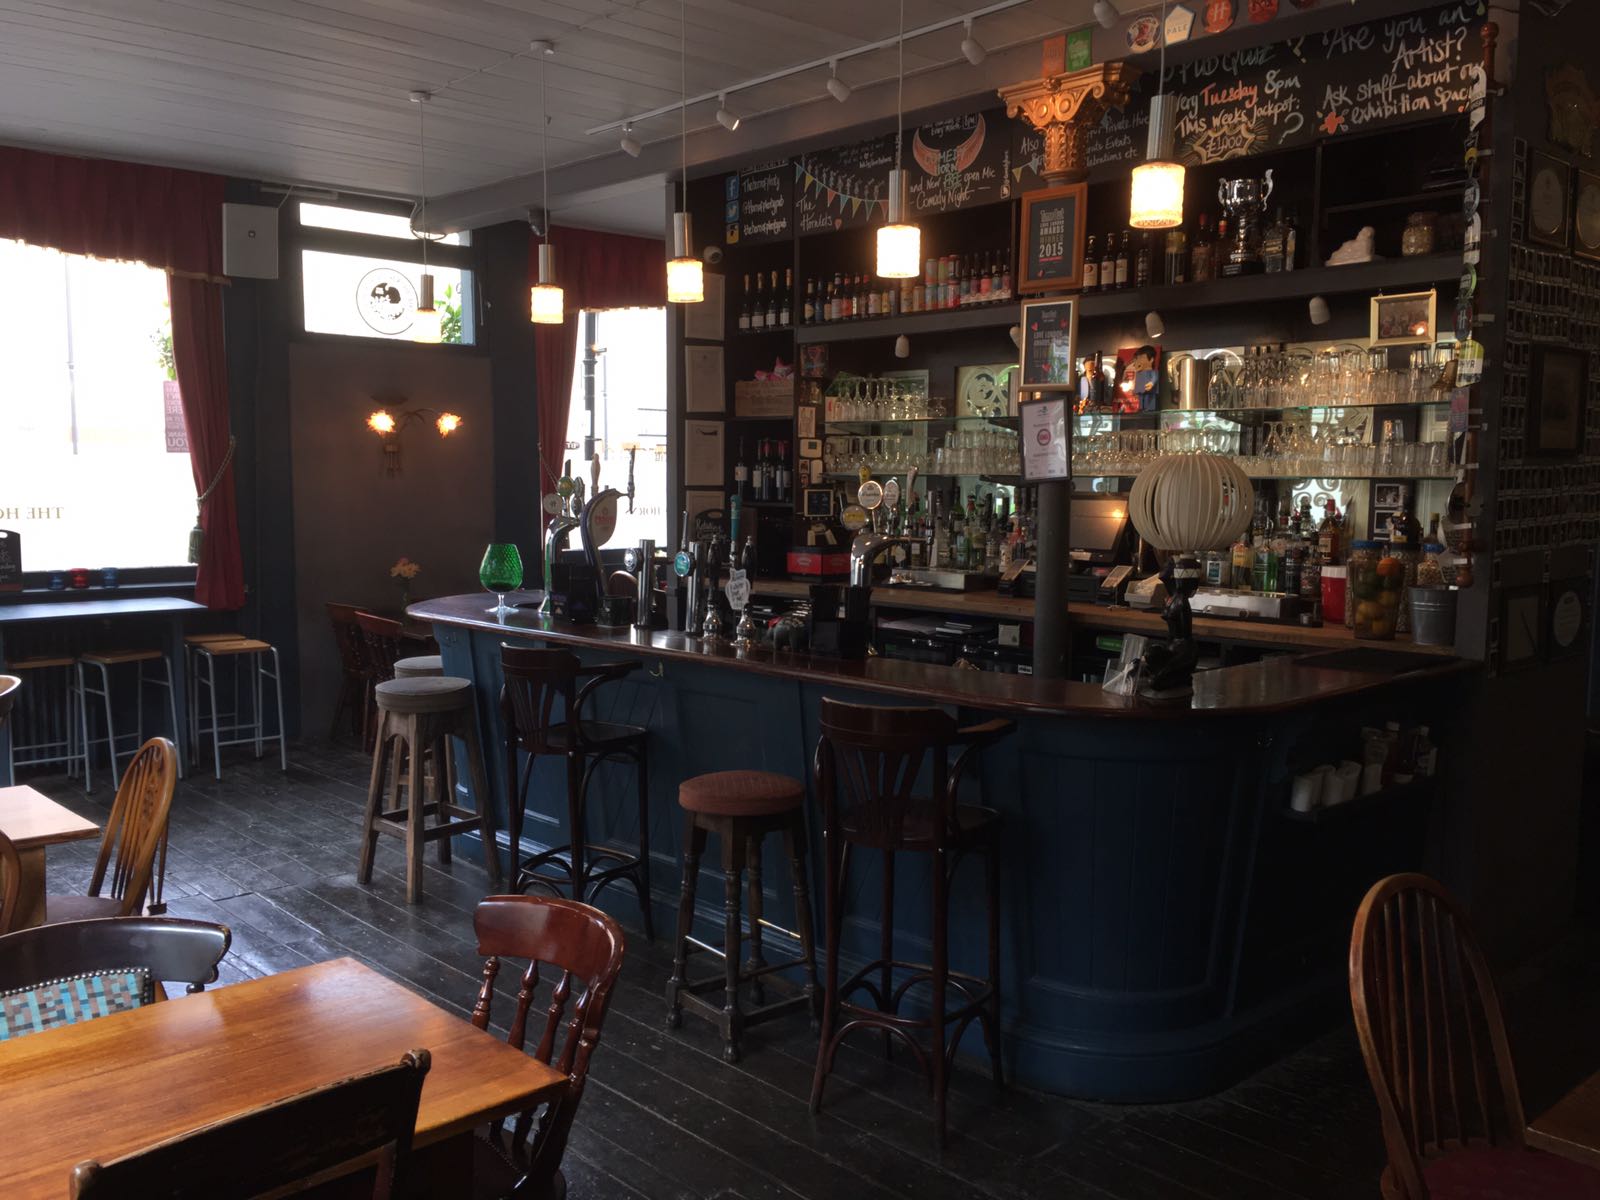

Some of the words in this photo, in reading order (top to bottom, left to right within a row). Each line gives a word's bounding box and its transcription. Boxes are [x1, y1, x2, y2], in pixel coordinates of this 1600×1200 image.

[1326, 25, 1376, 60] Are
[1382, 17, 1427, 54] you
[1438, 5, 1472, 26] an
[1407, 60, 1459, 91] about
[1200, 79, 1258, 109] Tuesday
[1434, 86, 1472, 112] Spac
[1174, 114, 1208, 138] This
[1020, 136, 1040, 155] Also
[1040, 242, 1063, 257] 2015
